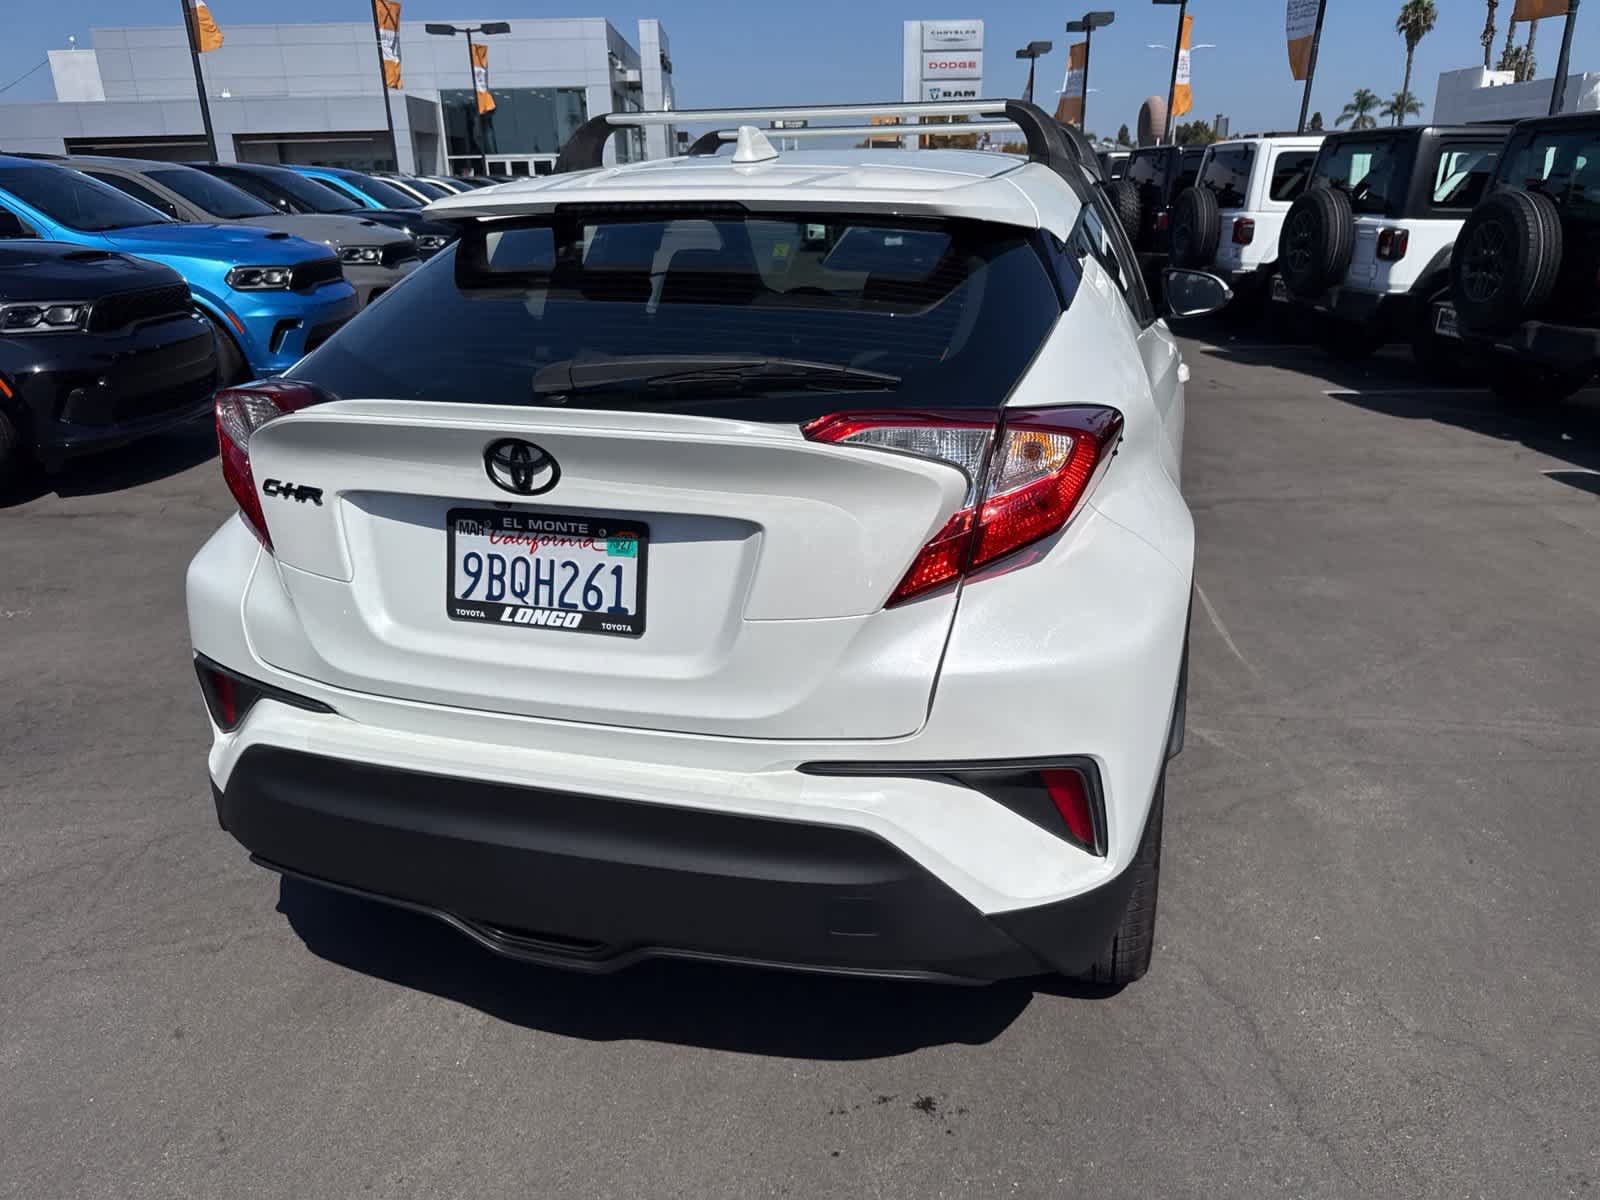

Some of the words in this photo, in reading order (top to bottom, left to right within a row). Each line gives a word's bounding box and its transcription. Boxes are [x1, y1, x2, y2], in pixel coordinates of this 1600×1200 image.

[928, 61, 976, 69] DODGE
[503, 517, 522, 529] EL
[528, 519, 589, 534] MONTE
[489, 528, 608, 554] California
[461, 551, 629, 616] 9BQH261
[456, 608, 486, 618] TOYOTA
[500, 606, 583, 629] LONGO
[602, 622, 632, 632] TOYOTA
